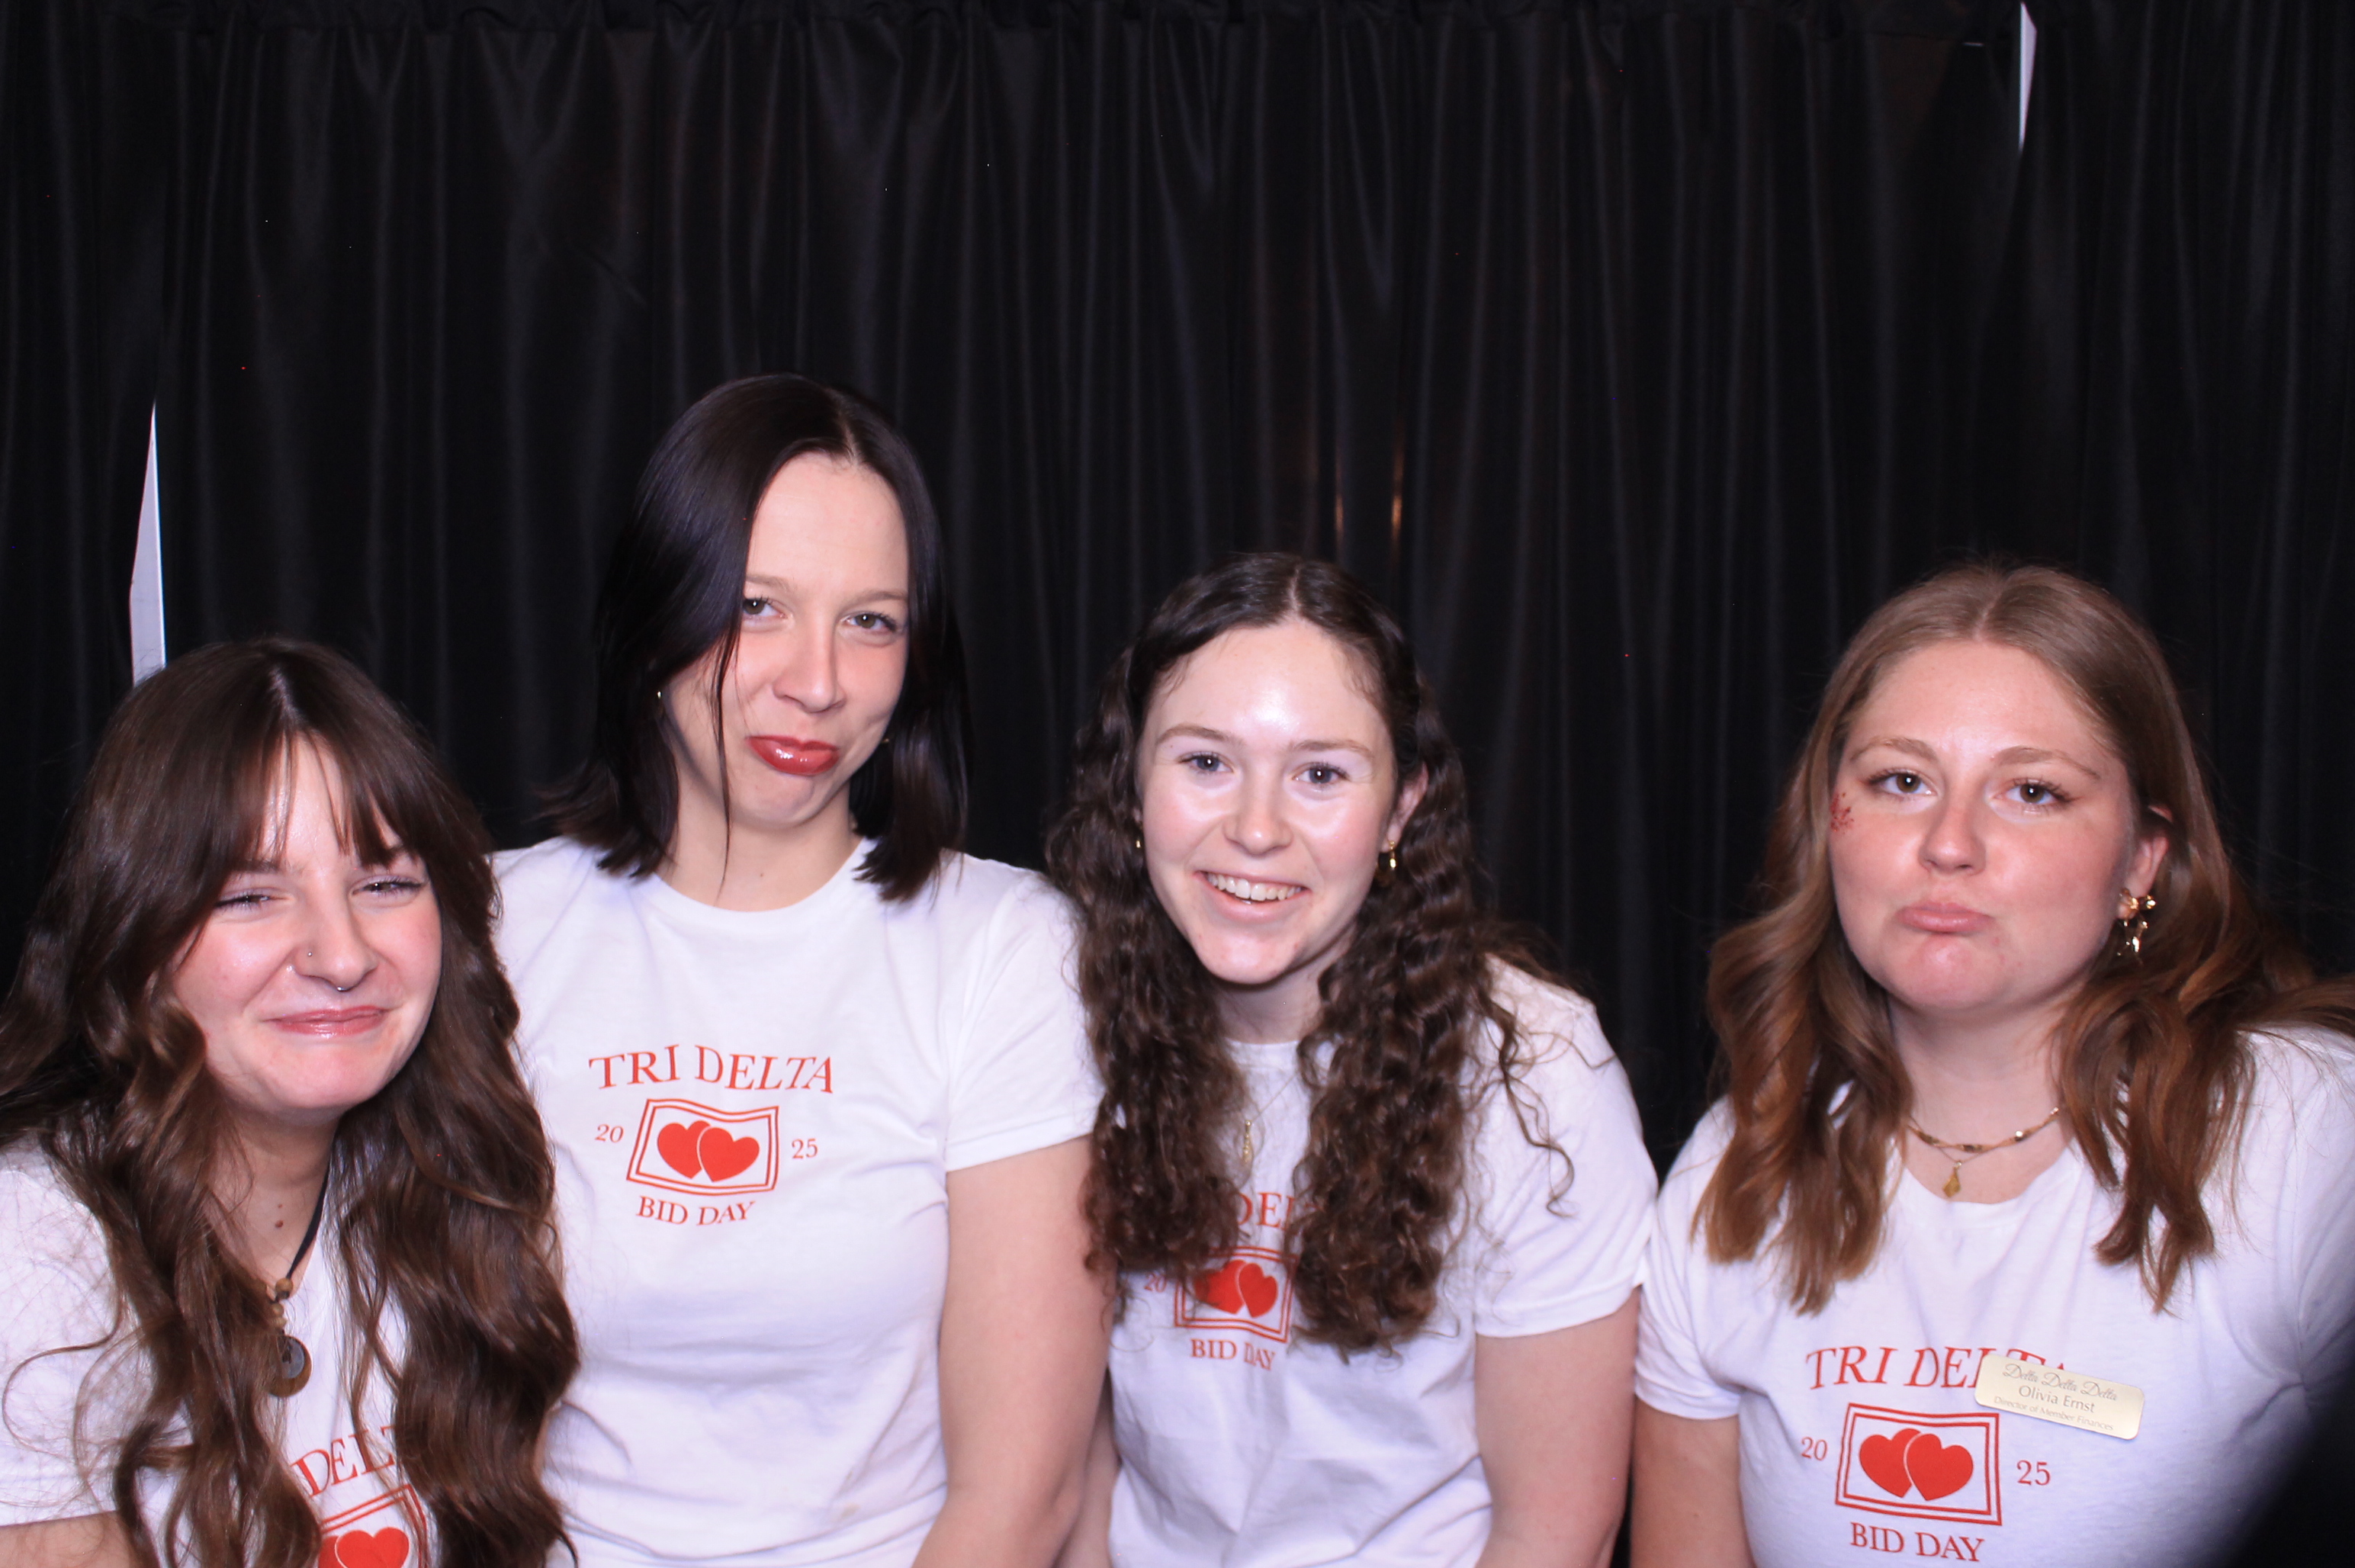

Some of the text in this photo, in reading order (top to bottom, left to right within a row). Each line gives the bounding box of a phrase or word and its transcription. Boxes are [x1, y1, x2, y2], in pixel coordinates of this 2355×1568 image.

[589, 1044, 834, 1094] TRI DELTA
[594, 1123, 818, 1159] 20 25
[636, 1195, 757, 1226] BID DAY
[1145, 1272, 1167, 1293] 20
[1190, 1338, 1277, 1371] BID DAY
[1805, 1345, 1898, 1390] TRI
[2002, 1363, 2118, 1401] Delta Delta Delta
[2019, 1385, 2096, 1413] Olivia Ernst
[1994, 1396, 2028, 1410] Director
[2040, 1407, 2074, 1421] Member
[1801, 1436, 2051, 1486] 20 25
[1849, 1521, 1985, 1563] BID DAY
